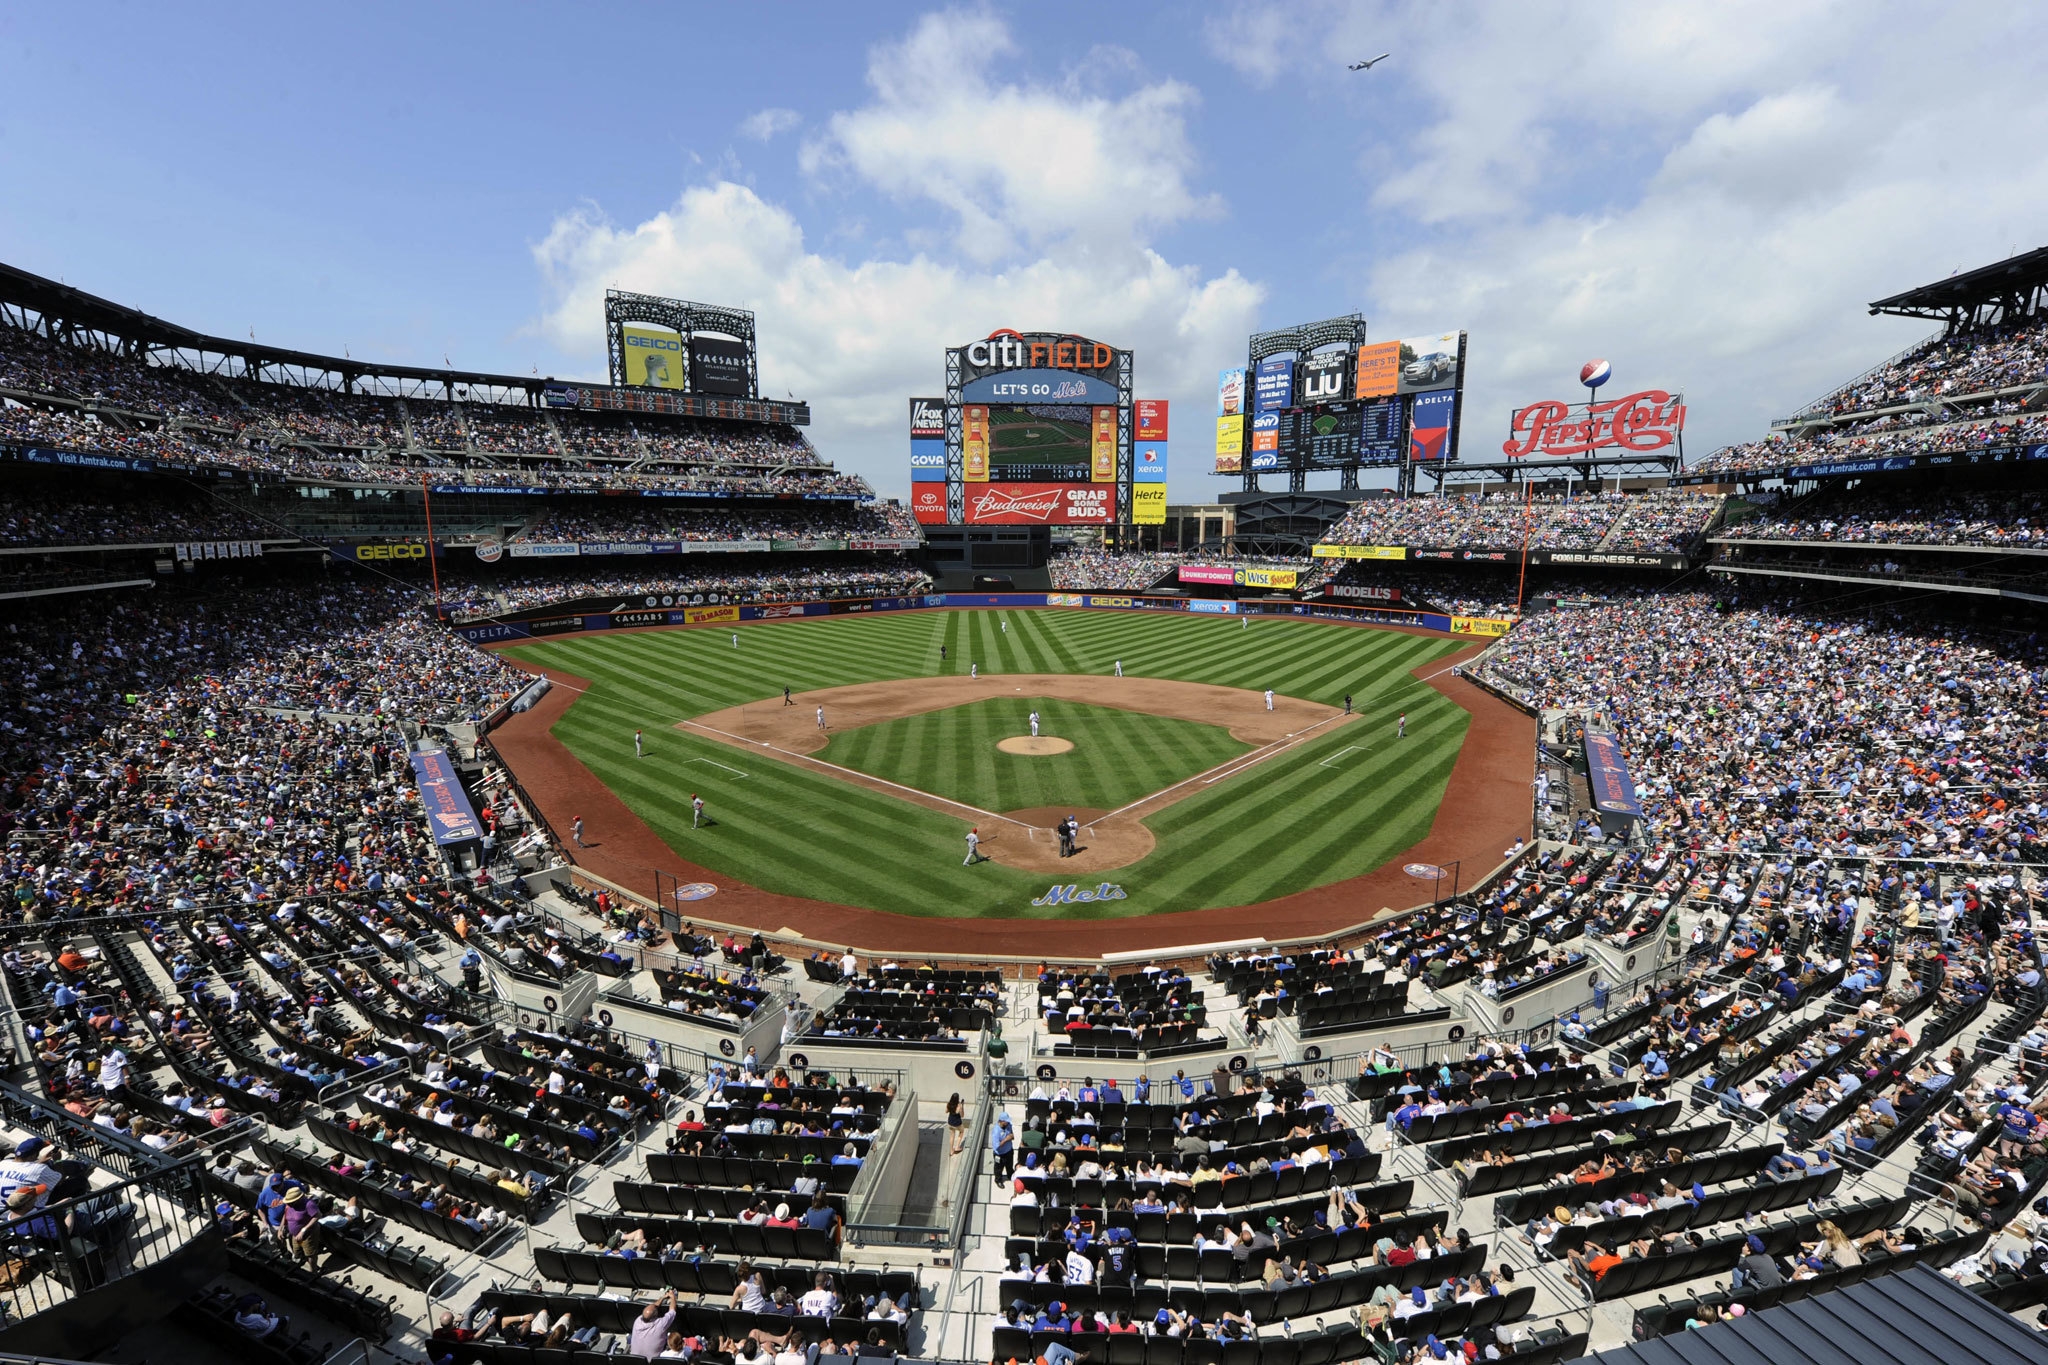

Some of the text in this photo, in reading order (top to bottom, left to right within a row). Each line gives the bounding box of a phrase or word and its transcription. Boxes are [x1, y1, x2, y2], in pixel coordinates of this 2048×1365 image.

[627, 336, 680, 352] GEICO
[968, 336, 1112, 368] citi FIELD
[696, 353, 747, 367] CAESARS
[1387, 356, 1396, 364] TO
[1257, 375, 1276, 384] Watch
[993, 381, 1087, 399] LET'S GO Mets
[1257, 383, 1276, 391] Listen
[1424, 396, 1453, 404] DELTA
[922, 409, 943, 419] FOX
[916, 419, 944, 429] NEWS
[1254, 419, 1275, 428] SNY
[57, 453, 127, 469] Visit Amtrak.com
[911, 455, 945, 466] GOYA
[1252, 457, 1273, 467] SNY
[1930, 456, 1952, 464] YOUNG
[1812, 463, 1876, 474] Visit Amtrak.com
[460, 486, 522, 494] Visit Amtrak.com
[1067, 490, 1107, 500] GRAB
[1135, 490, 1164, 500] Hertz
[972, 496, 1060, 512] Budweiser
[914, 505, 943, 514] TOYOTA
[1067, 507, 1106, 517] BUDS
[532, 545, 575, 554] mazda
[609, 542, 653, 552] Authority
[850, 541, 874, 549] BOB'S
[356, 544, 426, 560] GEICO
[478, 546, 499, 556] Gulf
[1186, 570, 1232, 580] DUNKIN' DONUTS
[1247, 572, 1269, 584] WISE
[1333, 585, 1392, 600] MODELL'S
[929, 597, 941, 606] citi
[1090, 597, 1133, 607] GEICO
[849, 603, 872, 611] verizon
[615, 613, 662, 623] CAESARS
[469, 627, 511, 640] DELTA
[1031, 883, 1127, 906] Mets
[1309, 1050, 1316, 1058] 14
[795, 1058, 803, 1066] 16
[1234, 1060, 1242, 1069] 15
[961, 1065, 969, 1075] 16
[1042, 1069, 1051, 1078] 15
[1084, 1090, 1094, 1102] 16
[1112, 1255, 1122, 1271] 5
[1069, 1264, 1082, 1282] 57
